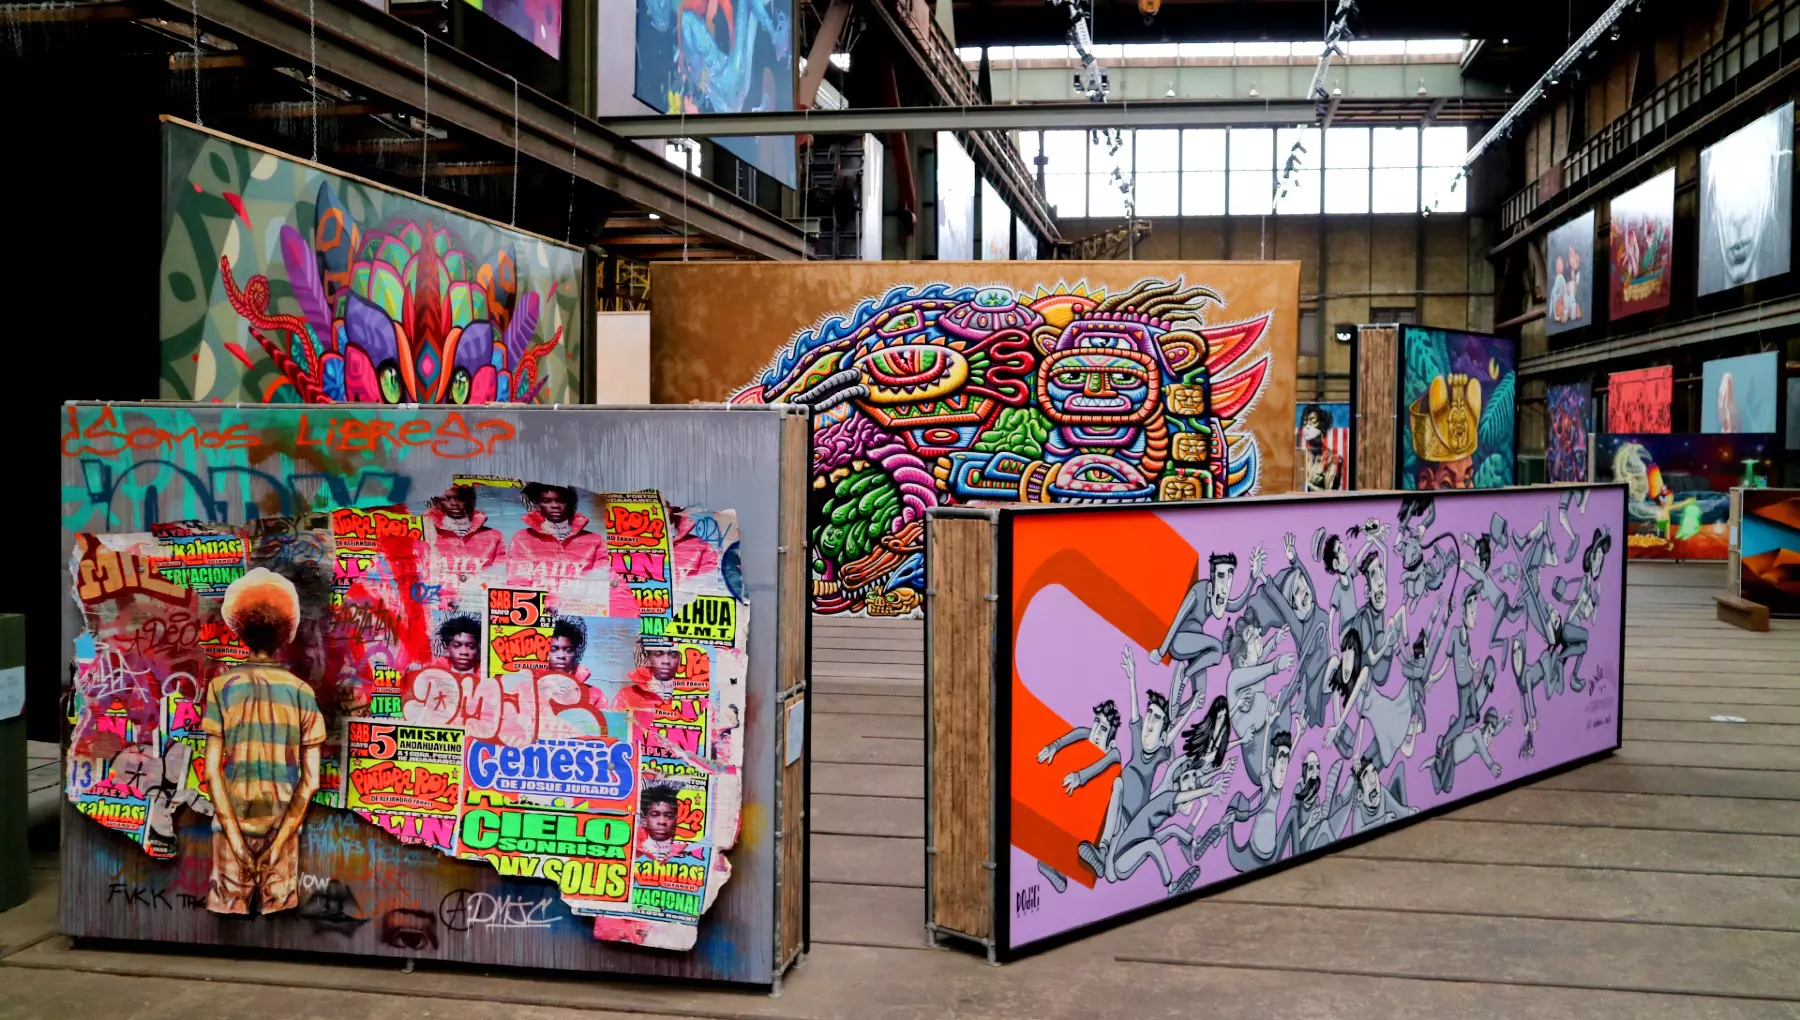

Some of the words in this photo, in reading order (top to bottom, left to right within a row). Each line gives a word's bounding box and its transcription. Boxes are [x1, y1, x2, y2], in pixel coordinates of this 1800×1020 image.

[490, 590, 511, 609] SAB
[510, 592, 539, 626] 5
[349, 722, 370, 743] SAB
[368, 725, 397, 759] 5
[400, 729, 461, 742] MISKY
[400, 741, 462, 753] ANDAHUAYLINO
[501, 779, 519, 789] DE
[521, 781, 562, 792] JOSUE
[564, 784, 620, 797] JURADO
[462, 808, 631, 849] CIELO
[498, 837, 626, 860] SONRISA
[542, 857, 628, 898] SOLIS
[634, 860, 705, 887] kahuasi
[632, 888, 700, 917] NACIONAL
